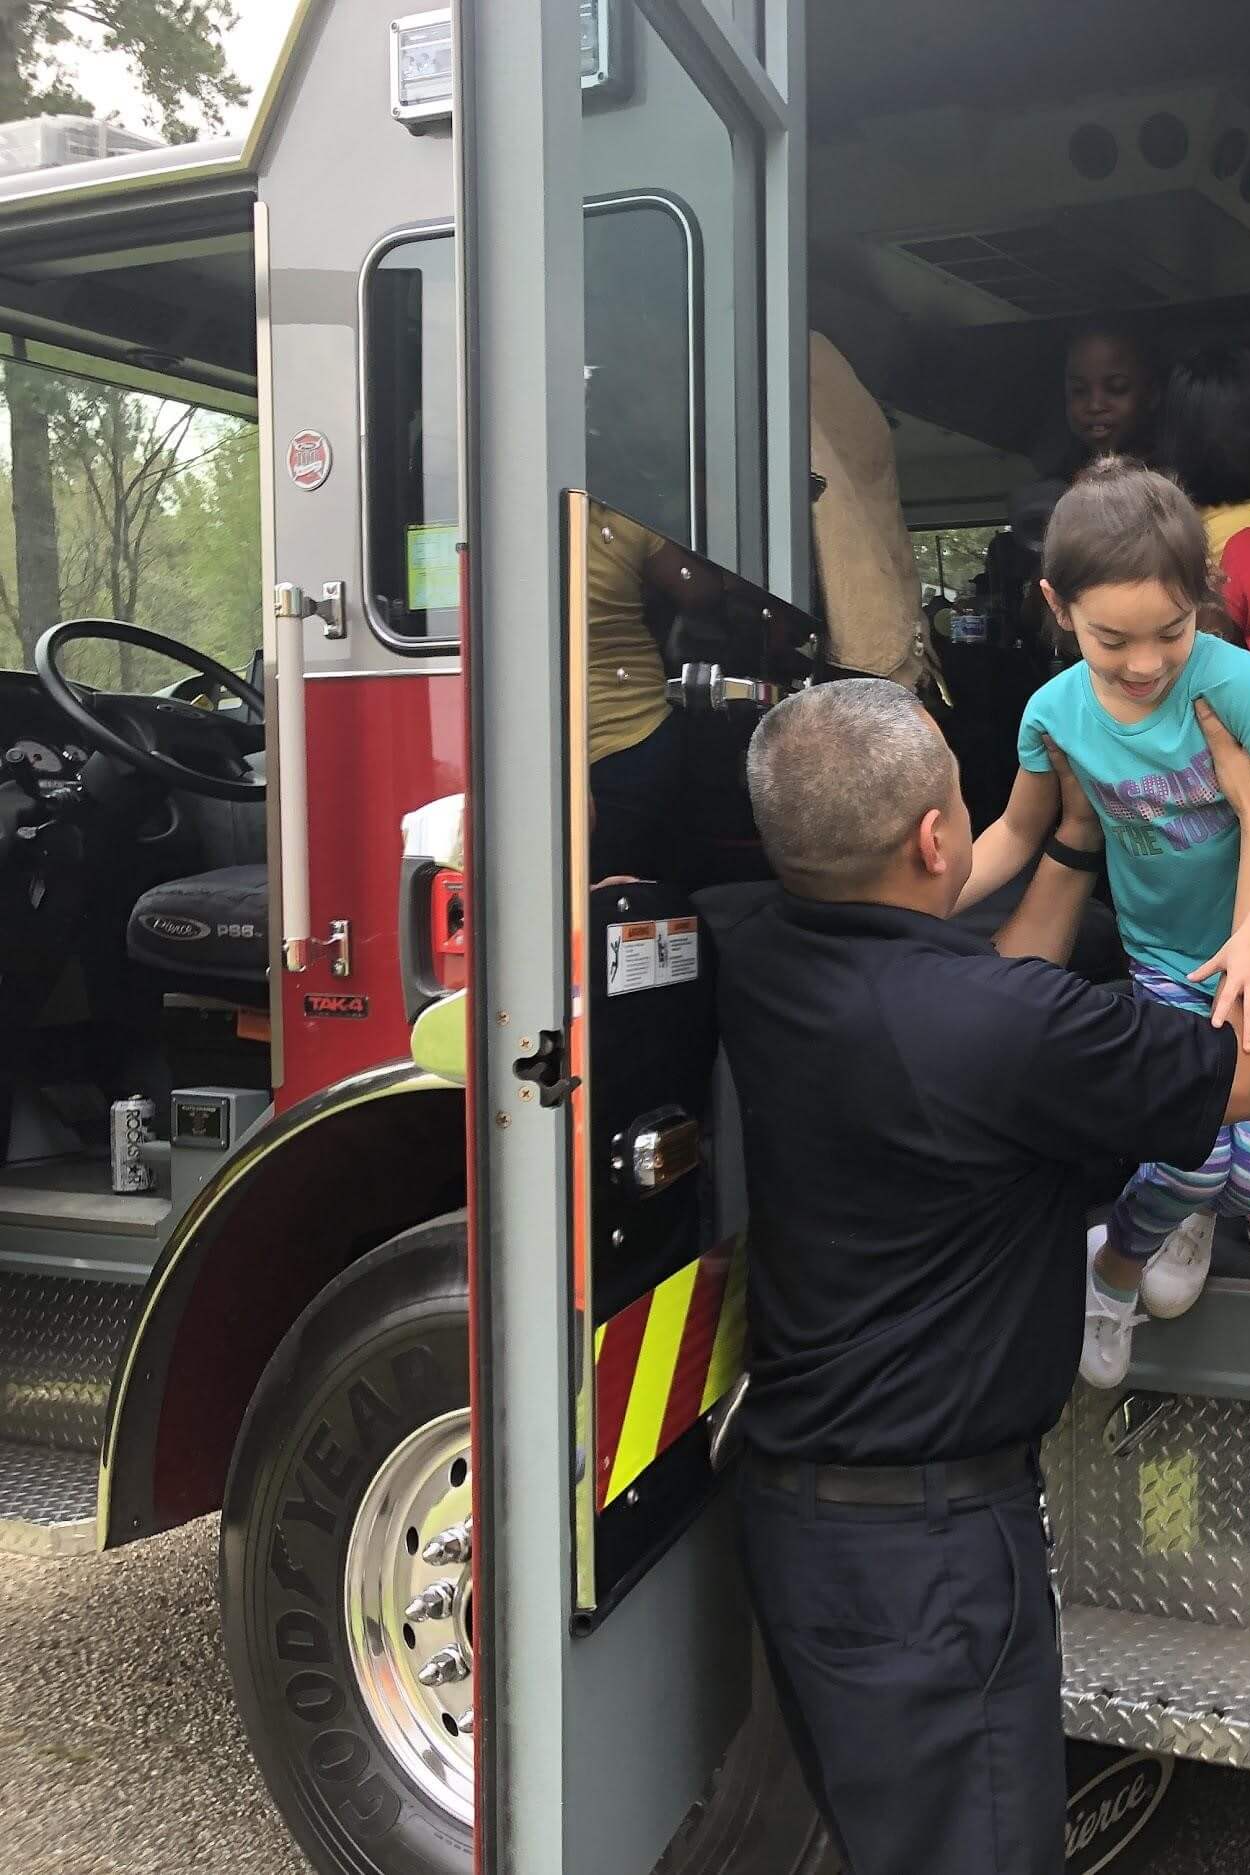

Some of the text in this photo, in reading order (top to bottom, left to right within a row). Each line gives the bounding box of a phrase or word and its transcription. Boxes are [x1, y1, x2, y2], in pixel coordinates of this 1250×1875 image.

[1113, 800, 1239, 856] THE WOR
[1064, 1772, 1147, 1860] ierce
